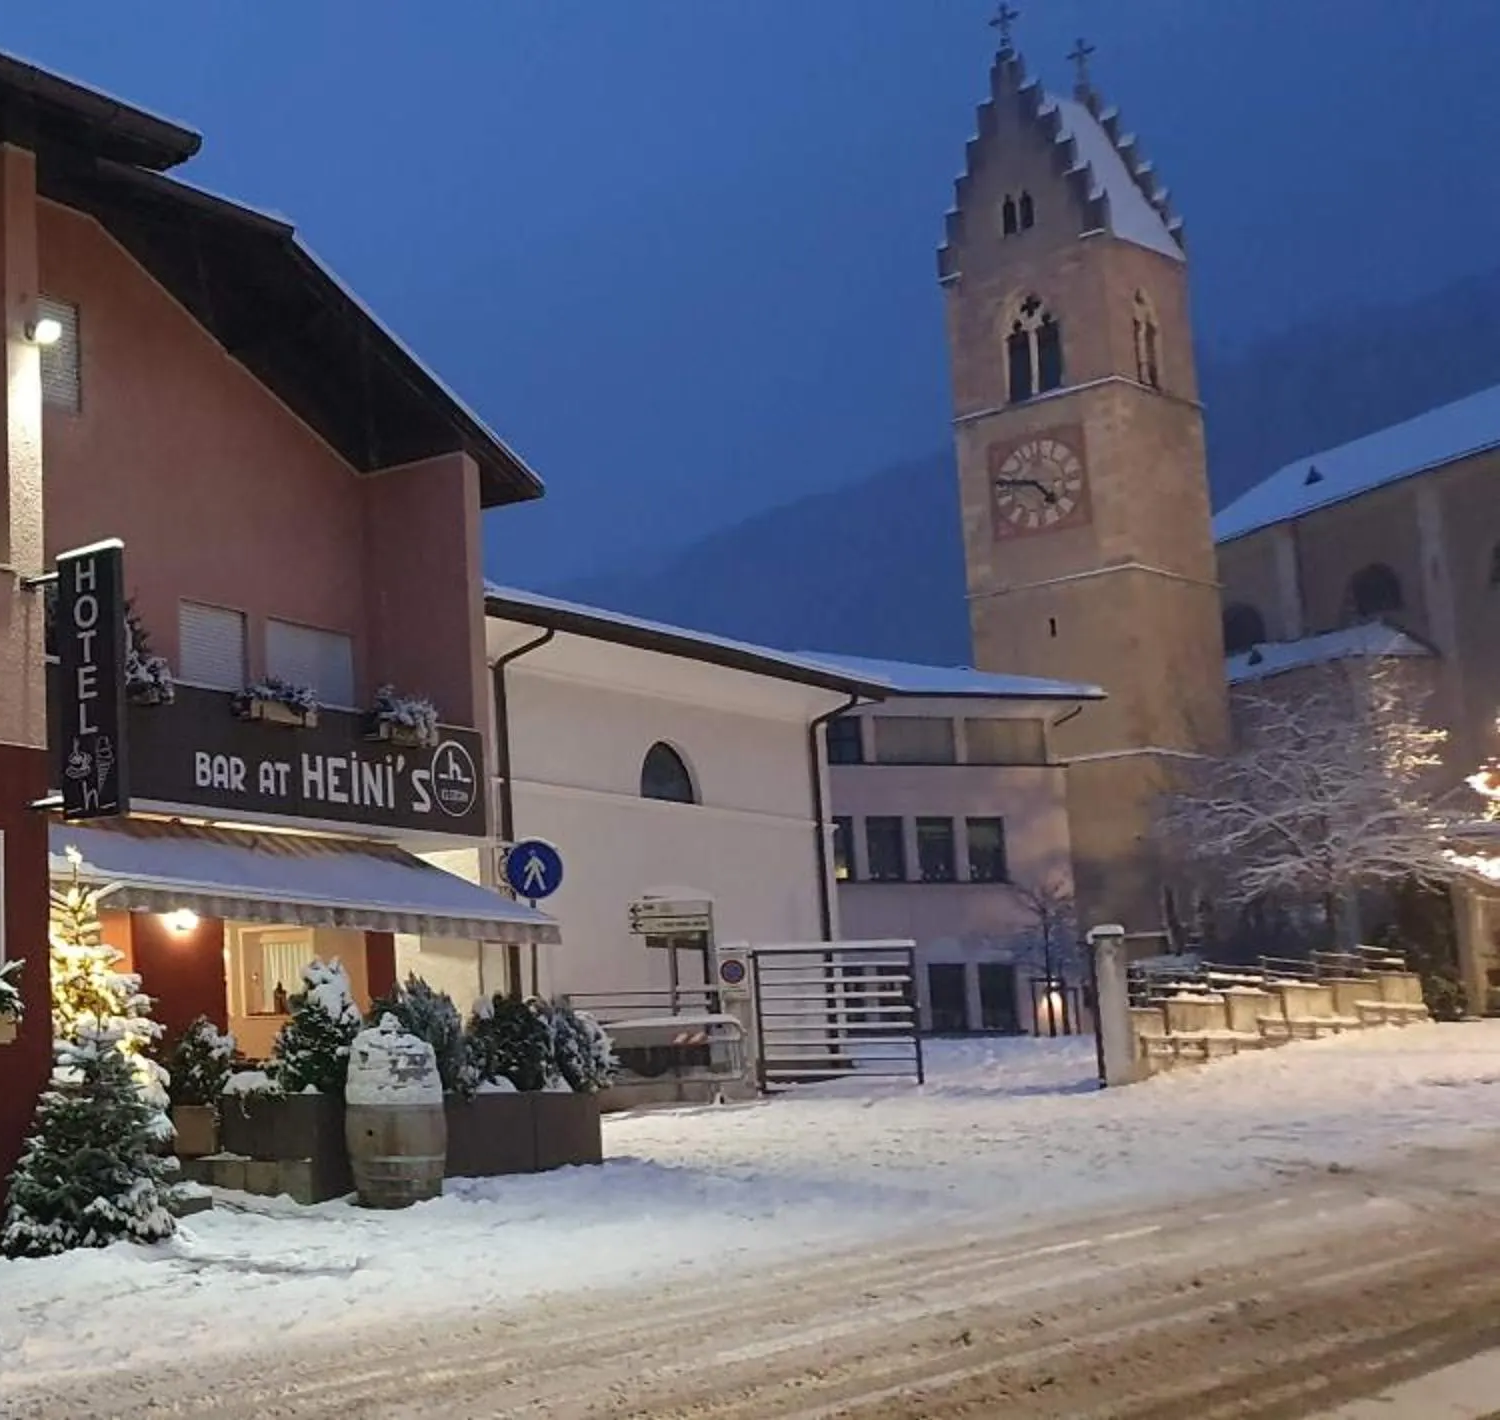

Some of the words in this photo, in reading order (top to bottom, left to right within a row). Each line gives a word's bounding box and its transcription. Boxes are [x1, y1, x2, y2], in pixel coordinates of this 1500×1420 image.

[73, 558, 98, 735] HOTEL
[195, 751, 246, 792] BAR
[259, 761, 291, 796] AT
